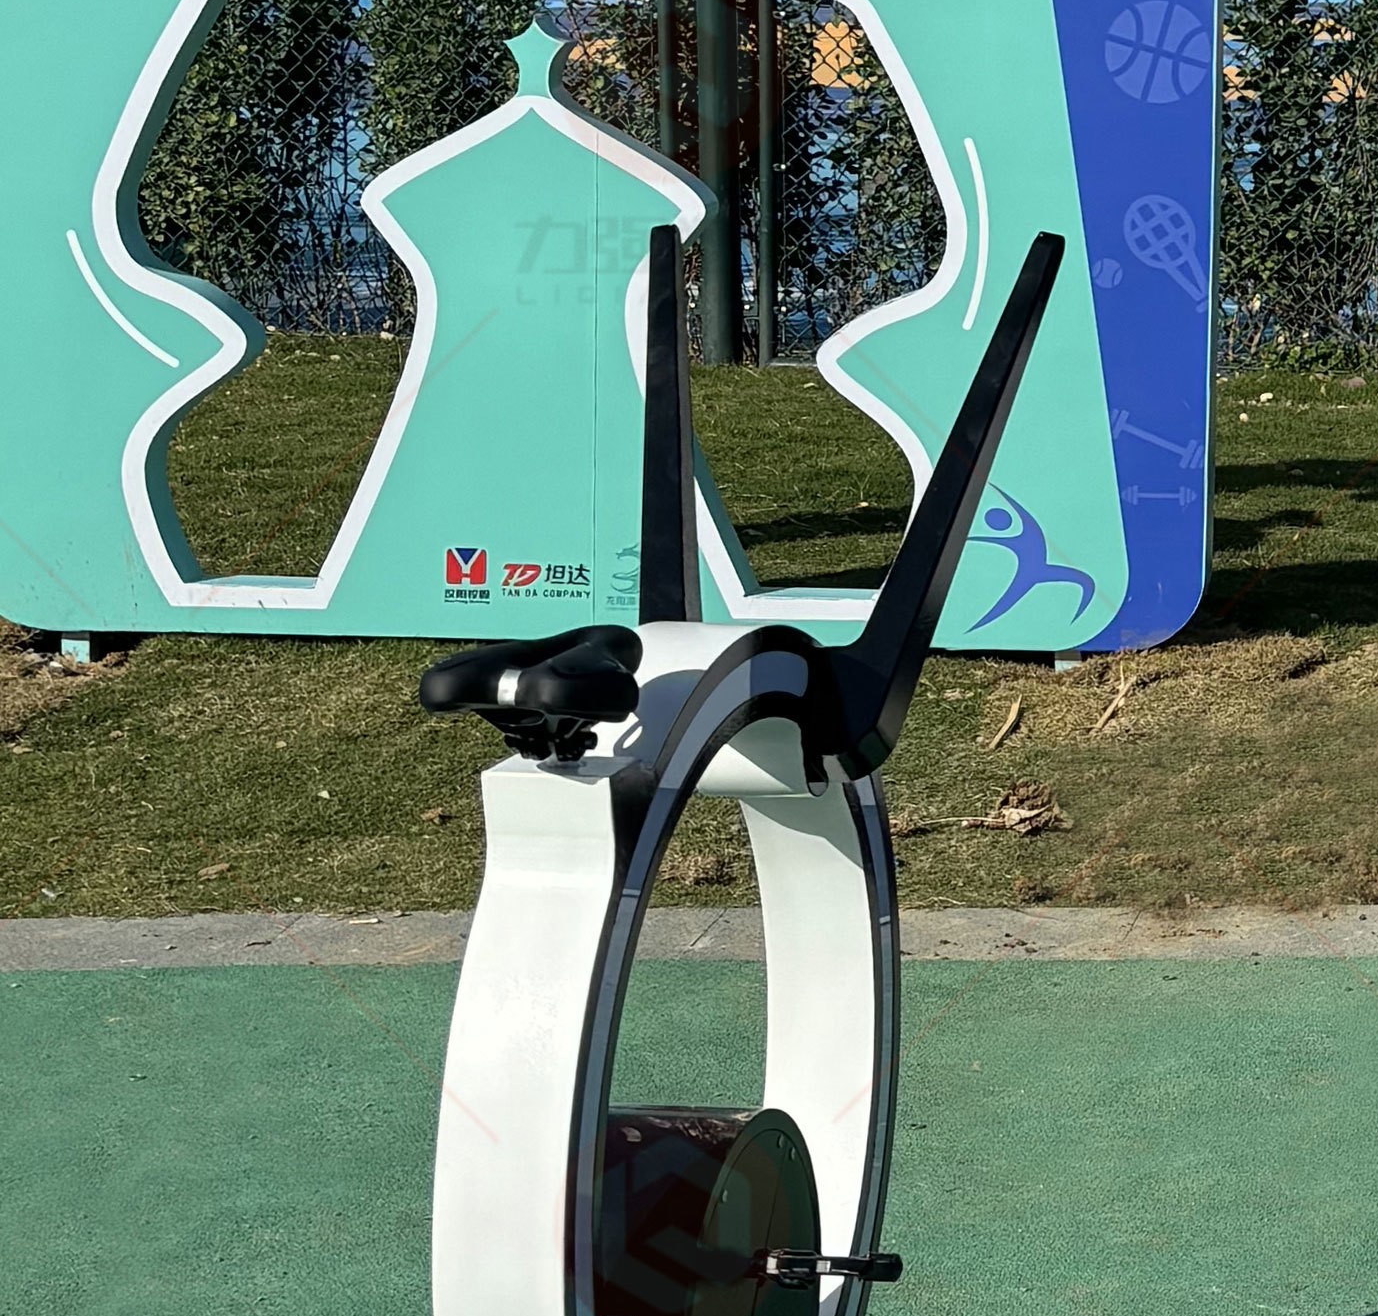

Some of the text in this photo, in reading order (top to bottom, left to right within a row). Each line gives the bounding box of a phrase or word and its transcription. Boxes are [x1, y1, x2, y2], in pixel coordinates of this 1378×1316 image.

[545, 563, 591, 586] 坦达
[502, 588, 591, 599] TAN DA COMPANY
